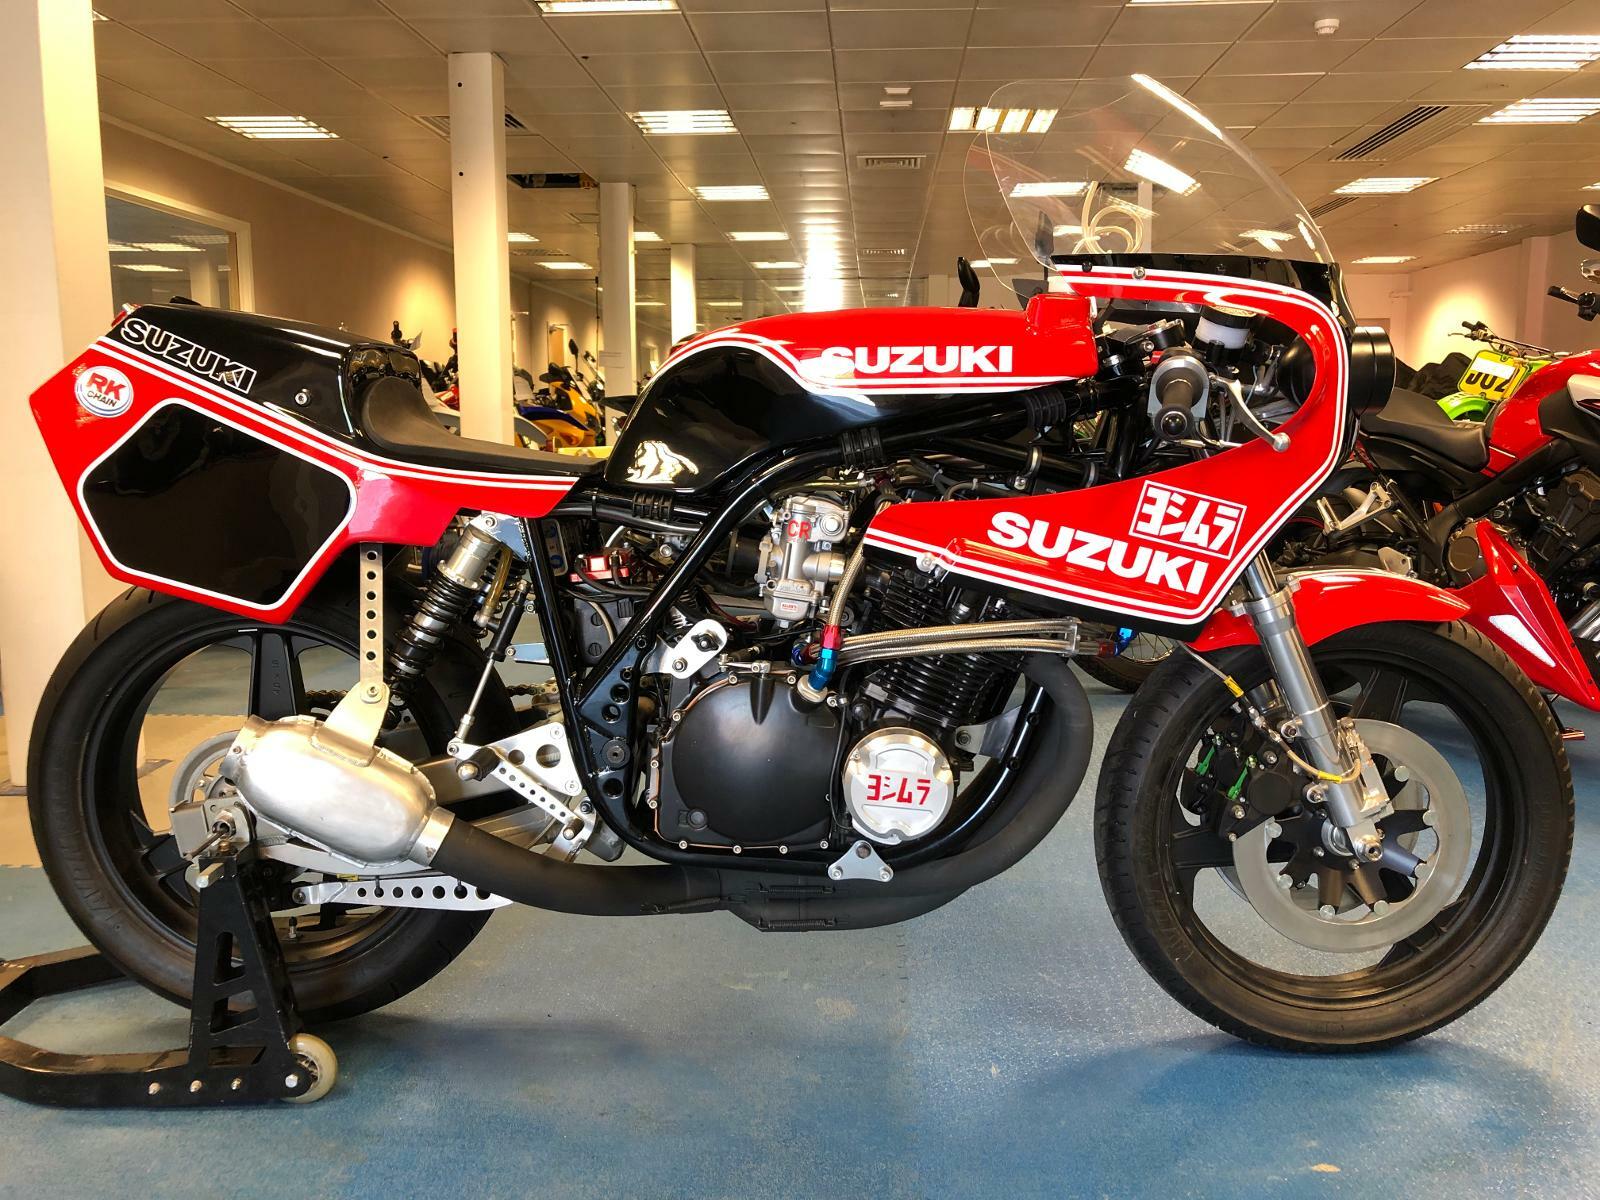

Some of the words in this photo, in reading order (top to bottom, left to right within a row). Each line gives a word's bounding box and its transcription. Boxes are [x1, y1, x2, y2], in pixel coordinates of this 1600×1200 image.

[121, 318, 257, 394] SUZUKI
[821, 345, 1013, 374] SUZUKI
[86, 372, 126, 400] RK
[87, 390, 117, 408] CHAIN
[787, 519, 812, 541] CR
[1136, 486, 1240, 551] ヨシムラ
[987, 511, 1209, 595] SUZUKI
[866, 774, 931, 805] ヨシムラ
